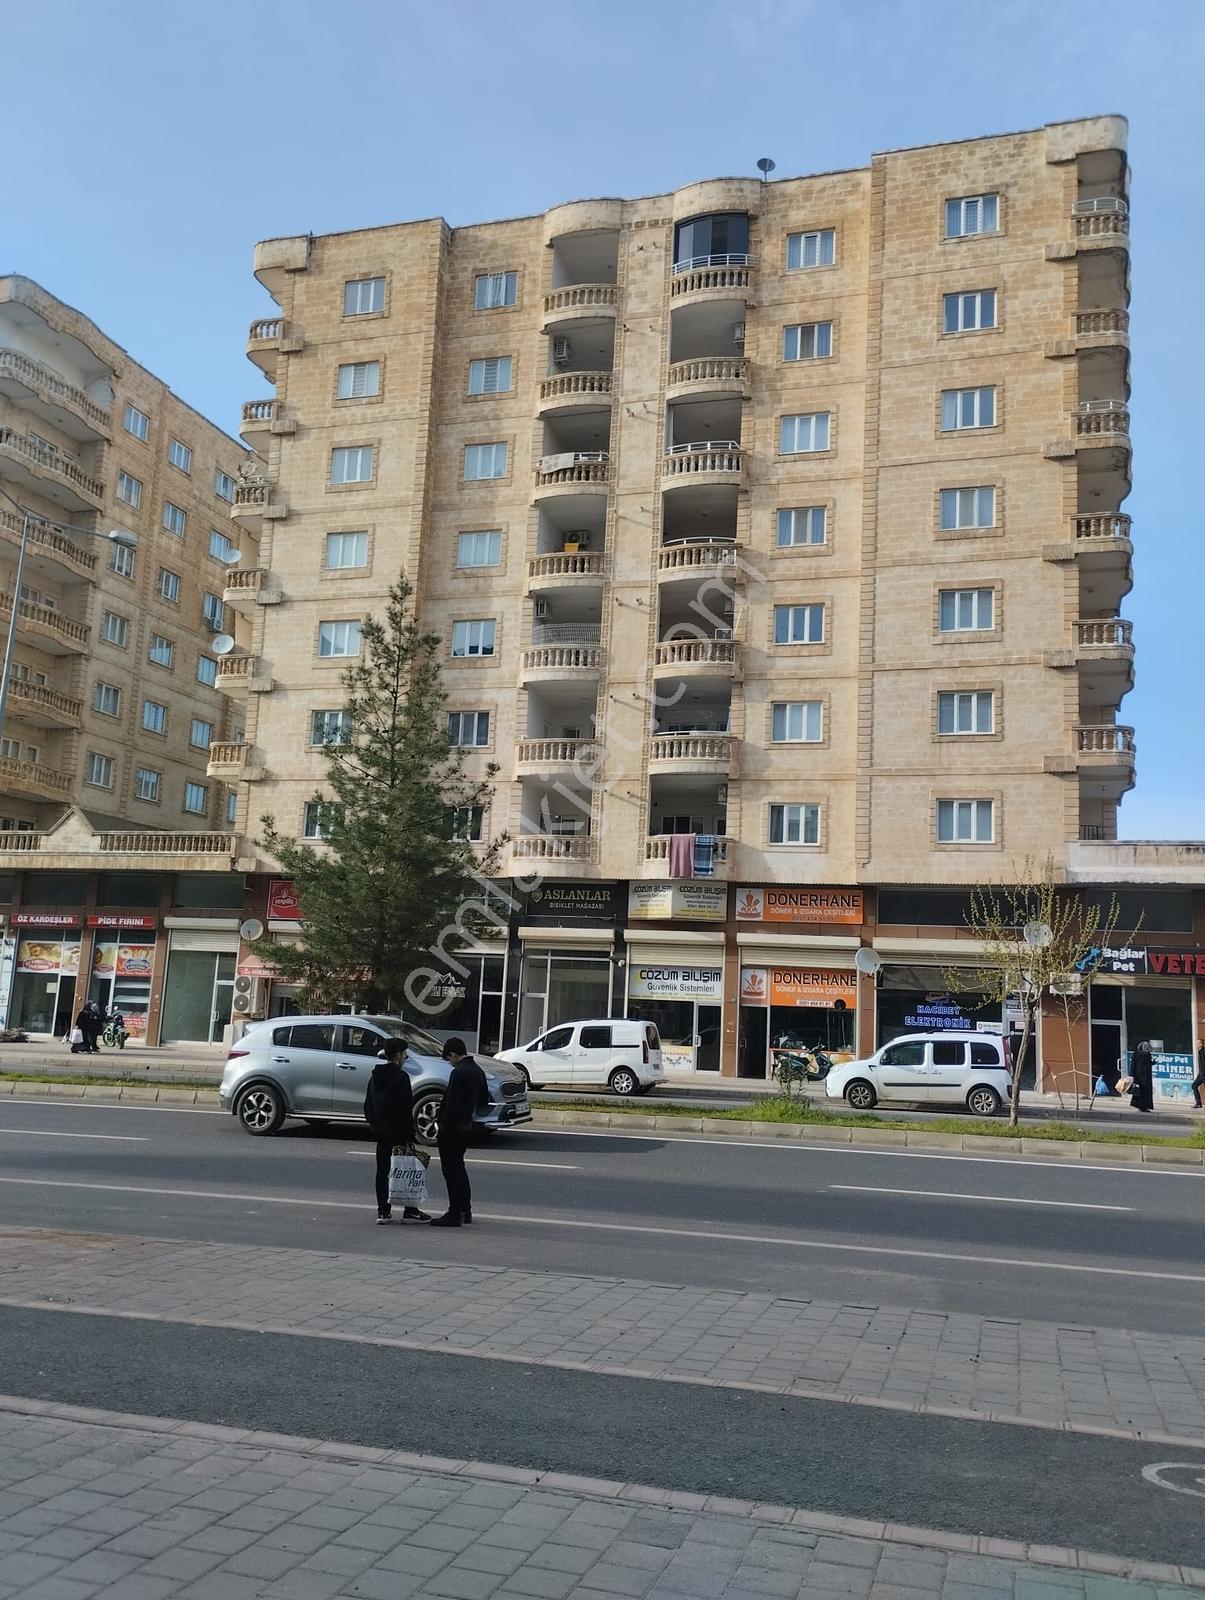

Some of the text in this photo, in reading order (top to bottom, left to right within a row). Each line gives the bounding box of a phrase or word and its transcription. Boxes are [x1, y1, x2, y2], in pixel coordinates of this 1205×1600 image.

[544, 889, 611, 901] ASLANLAR
[767, 891, 861, 908] DÖNERHANE
[770, 907, 793, 915] DÖNER
[17, 915, 73, 925] ÖZ KARDEŞLER
[97, 916, 144, 926] PİDE FIRINI
[1103, 947, 1144, 959] Bağlar
[1112, 961, 1135, 972] Pet
[773, 970, 857, 987] DÖNERHANE
[647, 982, 715, 993] Güvenlik Sistemleri
[775, 985, 797, 993] DÖNER
[904, 1016, 971, 1029] ELEKTRONİK
[1174, 1056, 1188, 1064] Pet
[1151, 1063, 1193, 1074] ERİNER
